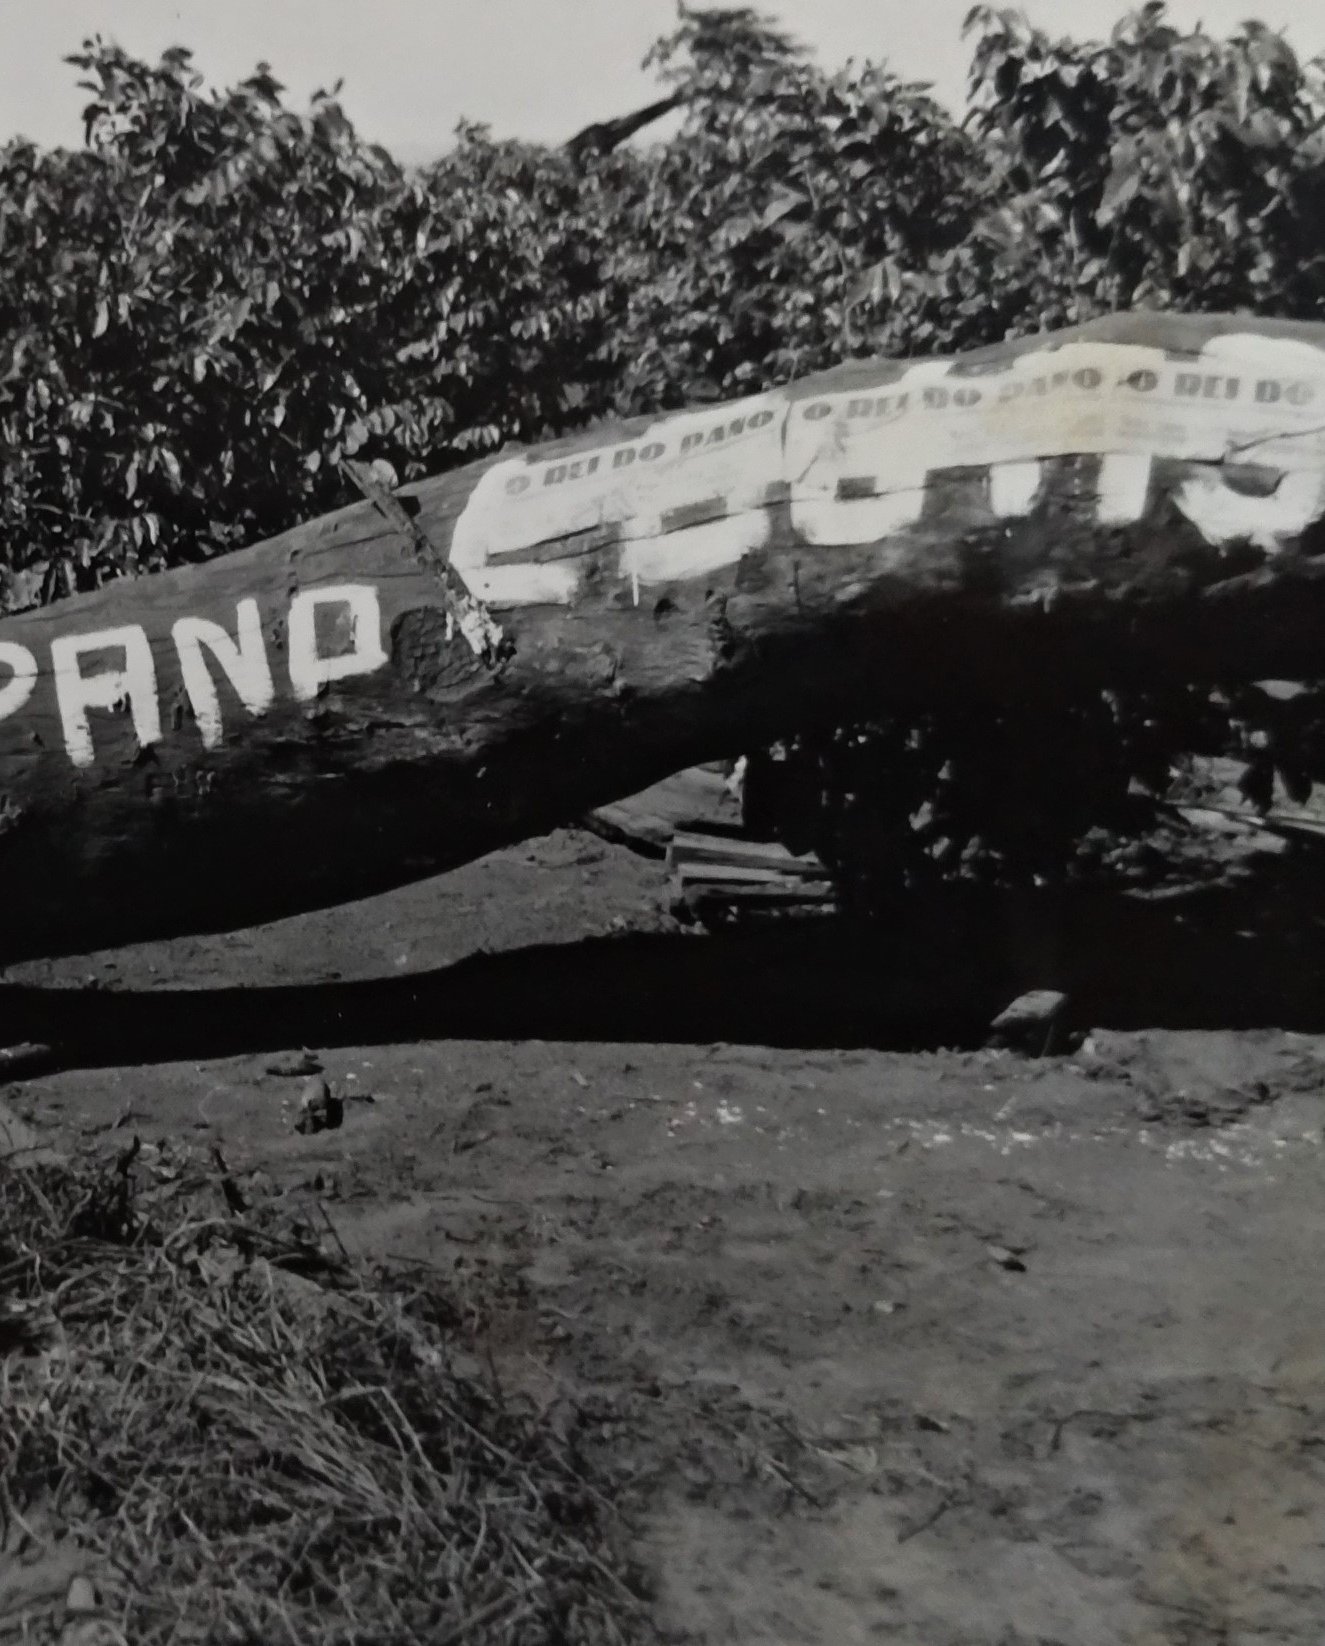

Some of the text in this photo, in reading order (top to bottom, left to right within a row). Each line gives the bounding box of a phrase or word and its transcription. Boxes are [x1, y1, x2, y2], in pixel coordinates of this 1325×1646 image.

[923, 386, 983, 410] DO
[612, 441, 667, 470] DO
[678, 409, 775, 453] PANO
